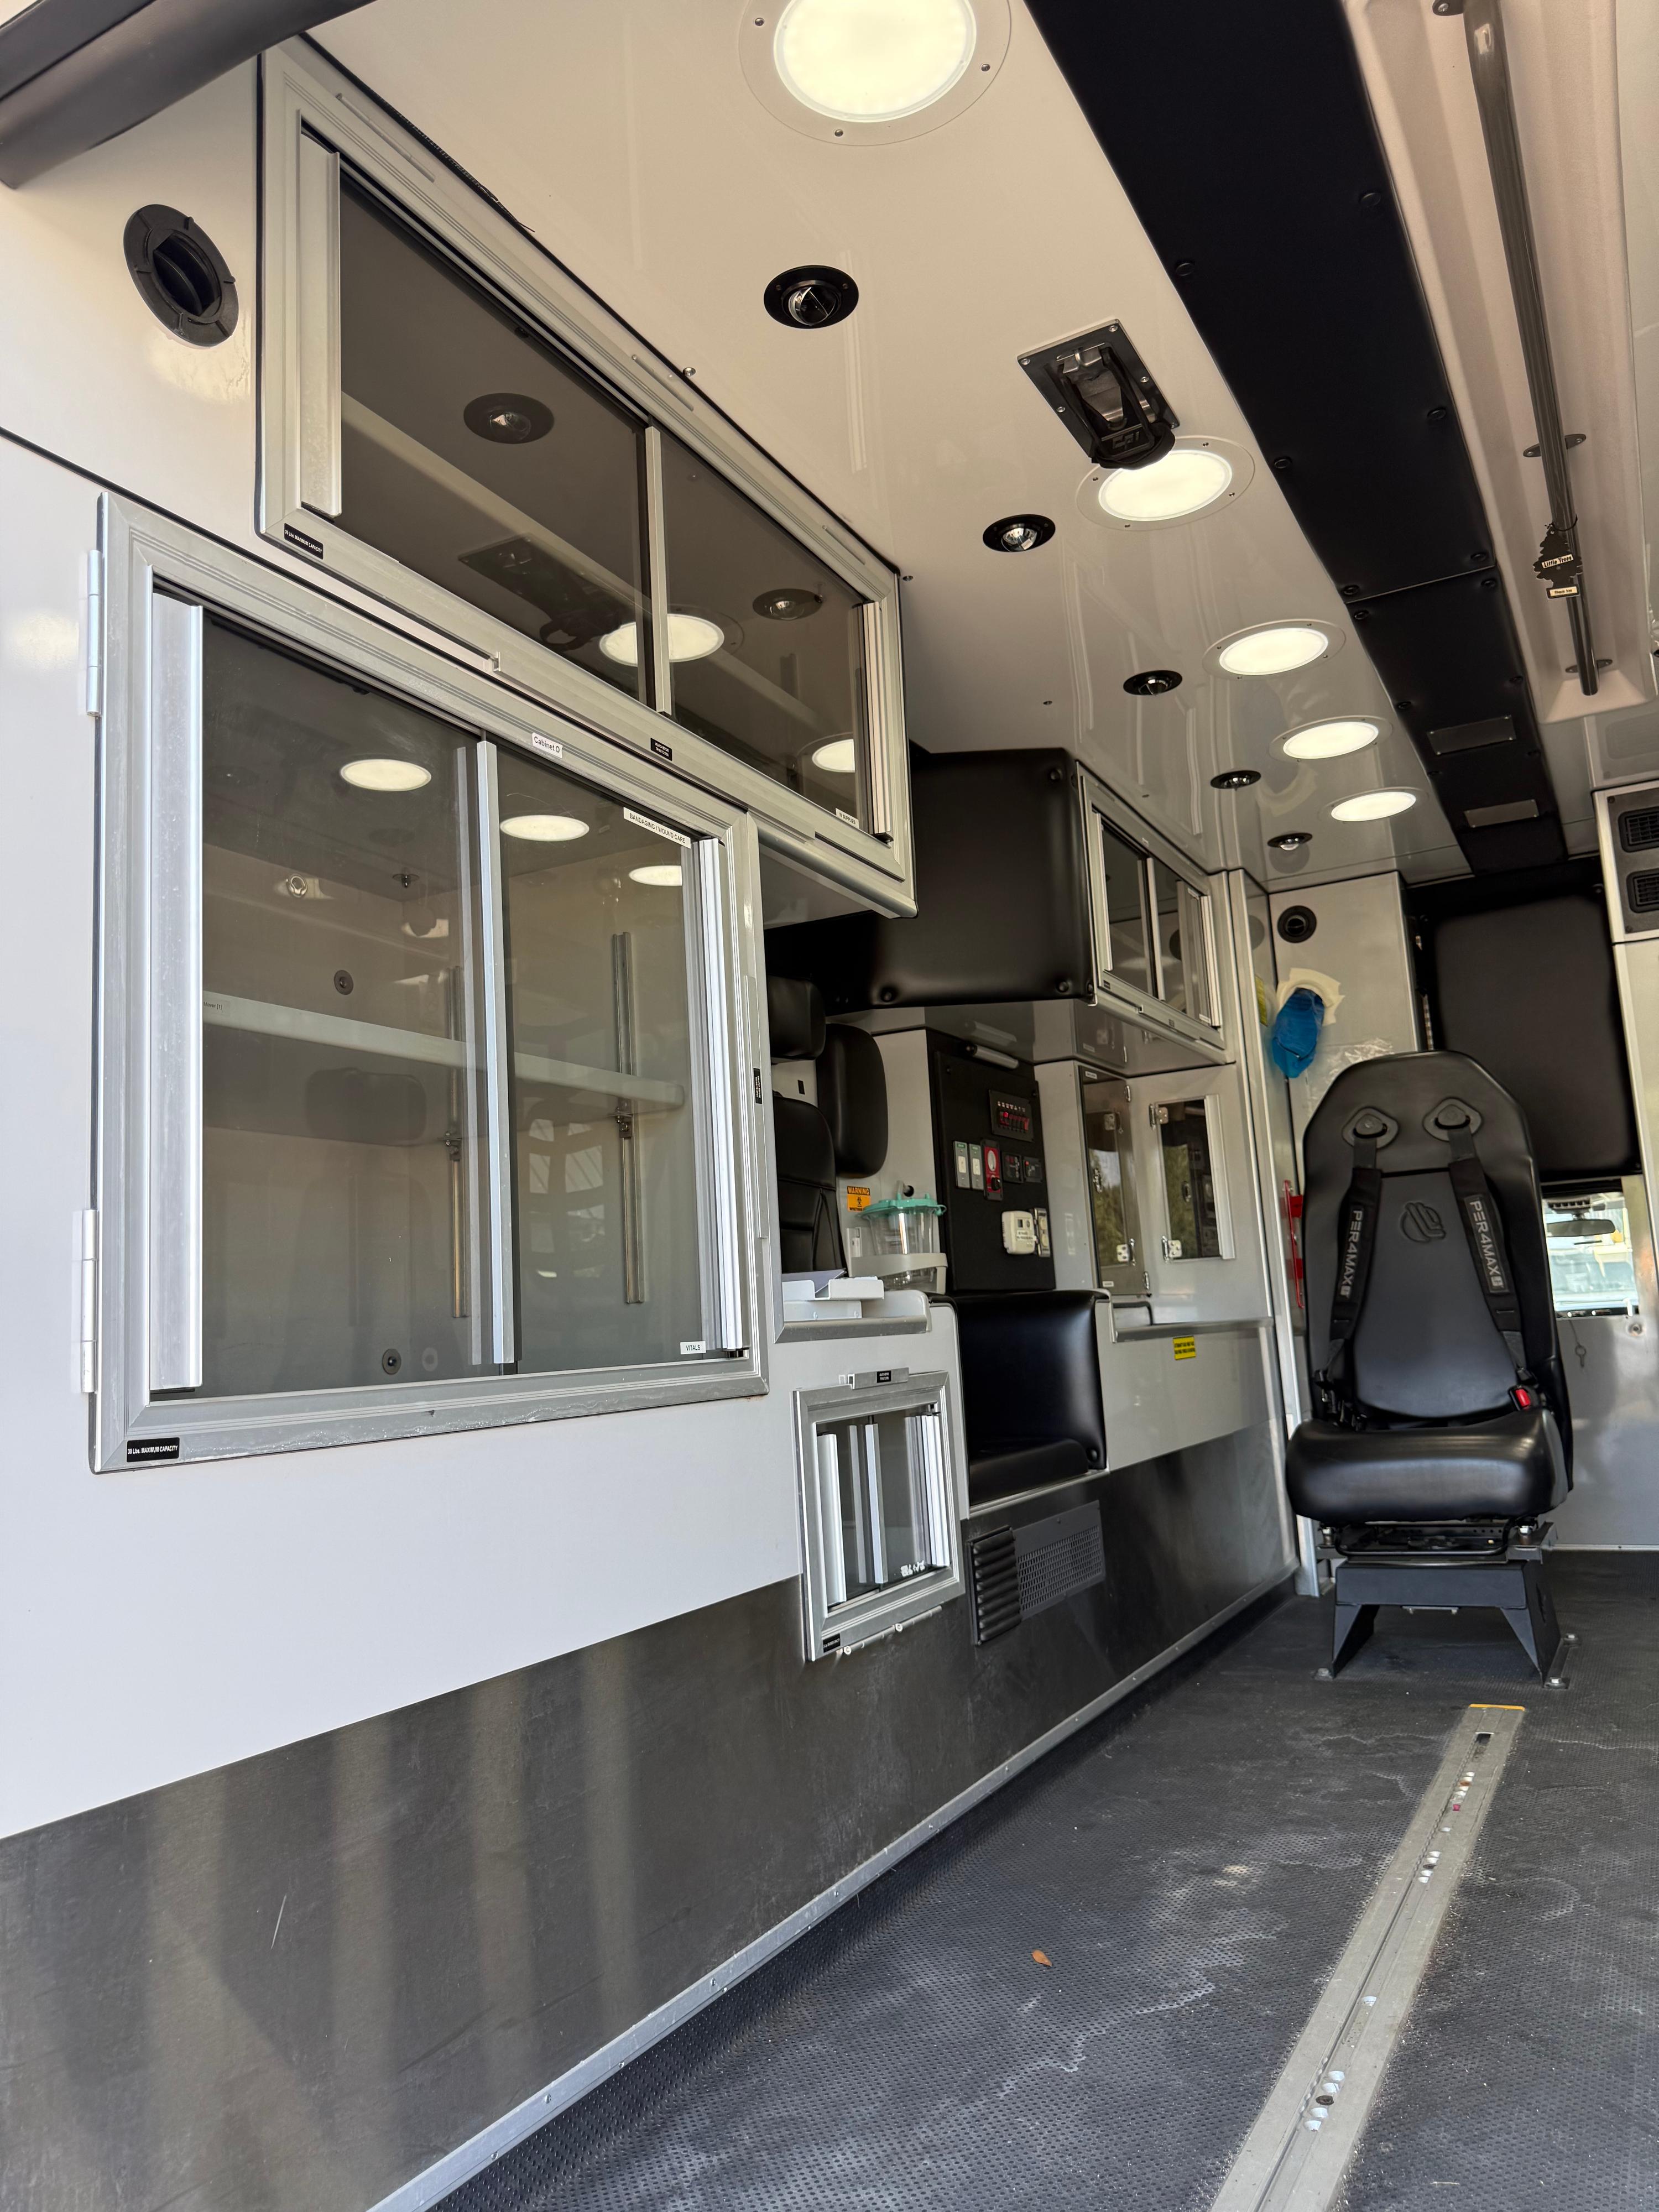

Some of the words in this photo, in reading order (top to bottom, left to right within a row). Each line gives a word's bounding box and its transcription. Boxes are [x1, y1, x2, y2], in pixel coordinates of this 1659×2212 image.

[309, 542, 322, 554] CAPACITY
[1543, 559, 1557, 568] Little
[534, 736, 555, 752] Cabinet
[629, 813, 655, 830] BANDAGING
[658, 827, 674, 838] WOUND
[674, 834, 686, 844] CARE
[848, 1187, 869, 1195] WARNING
